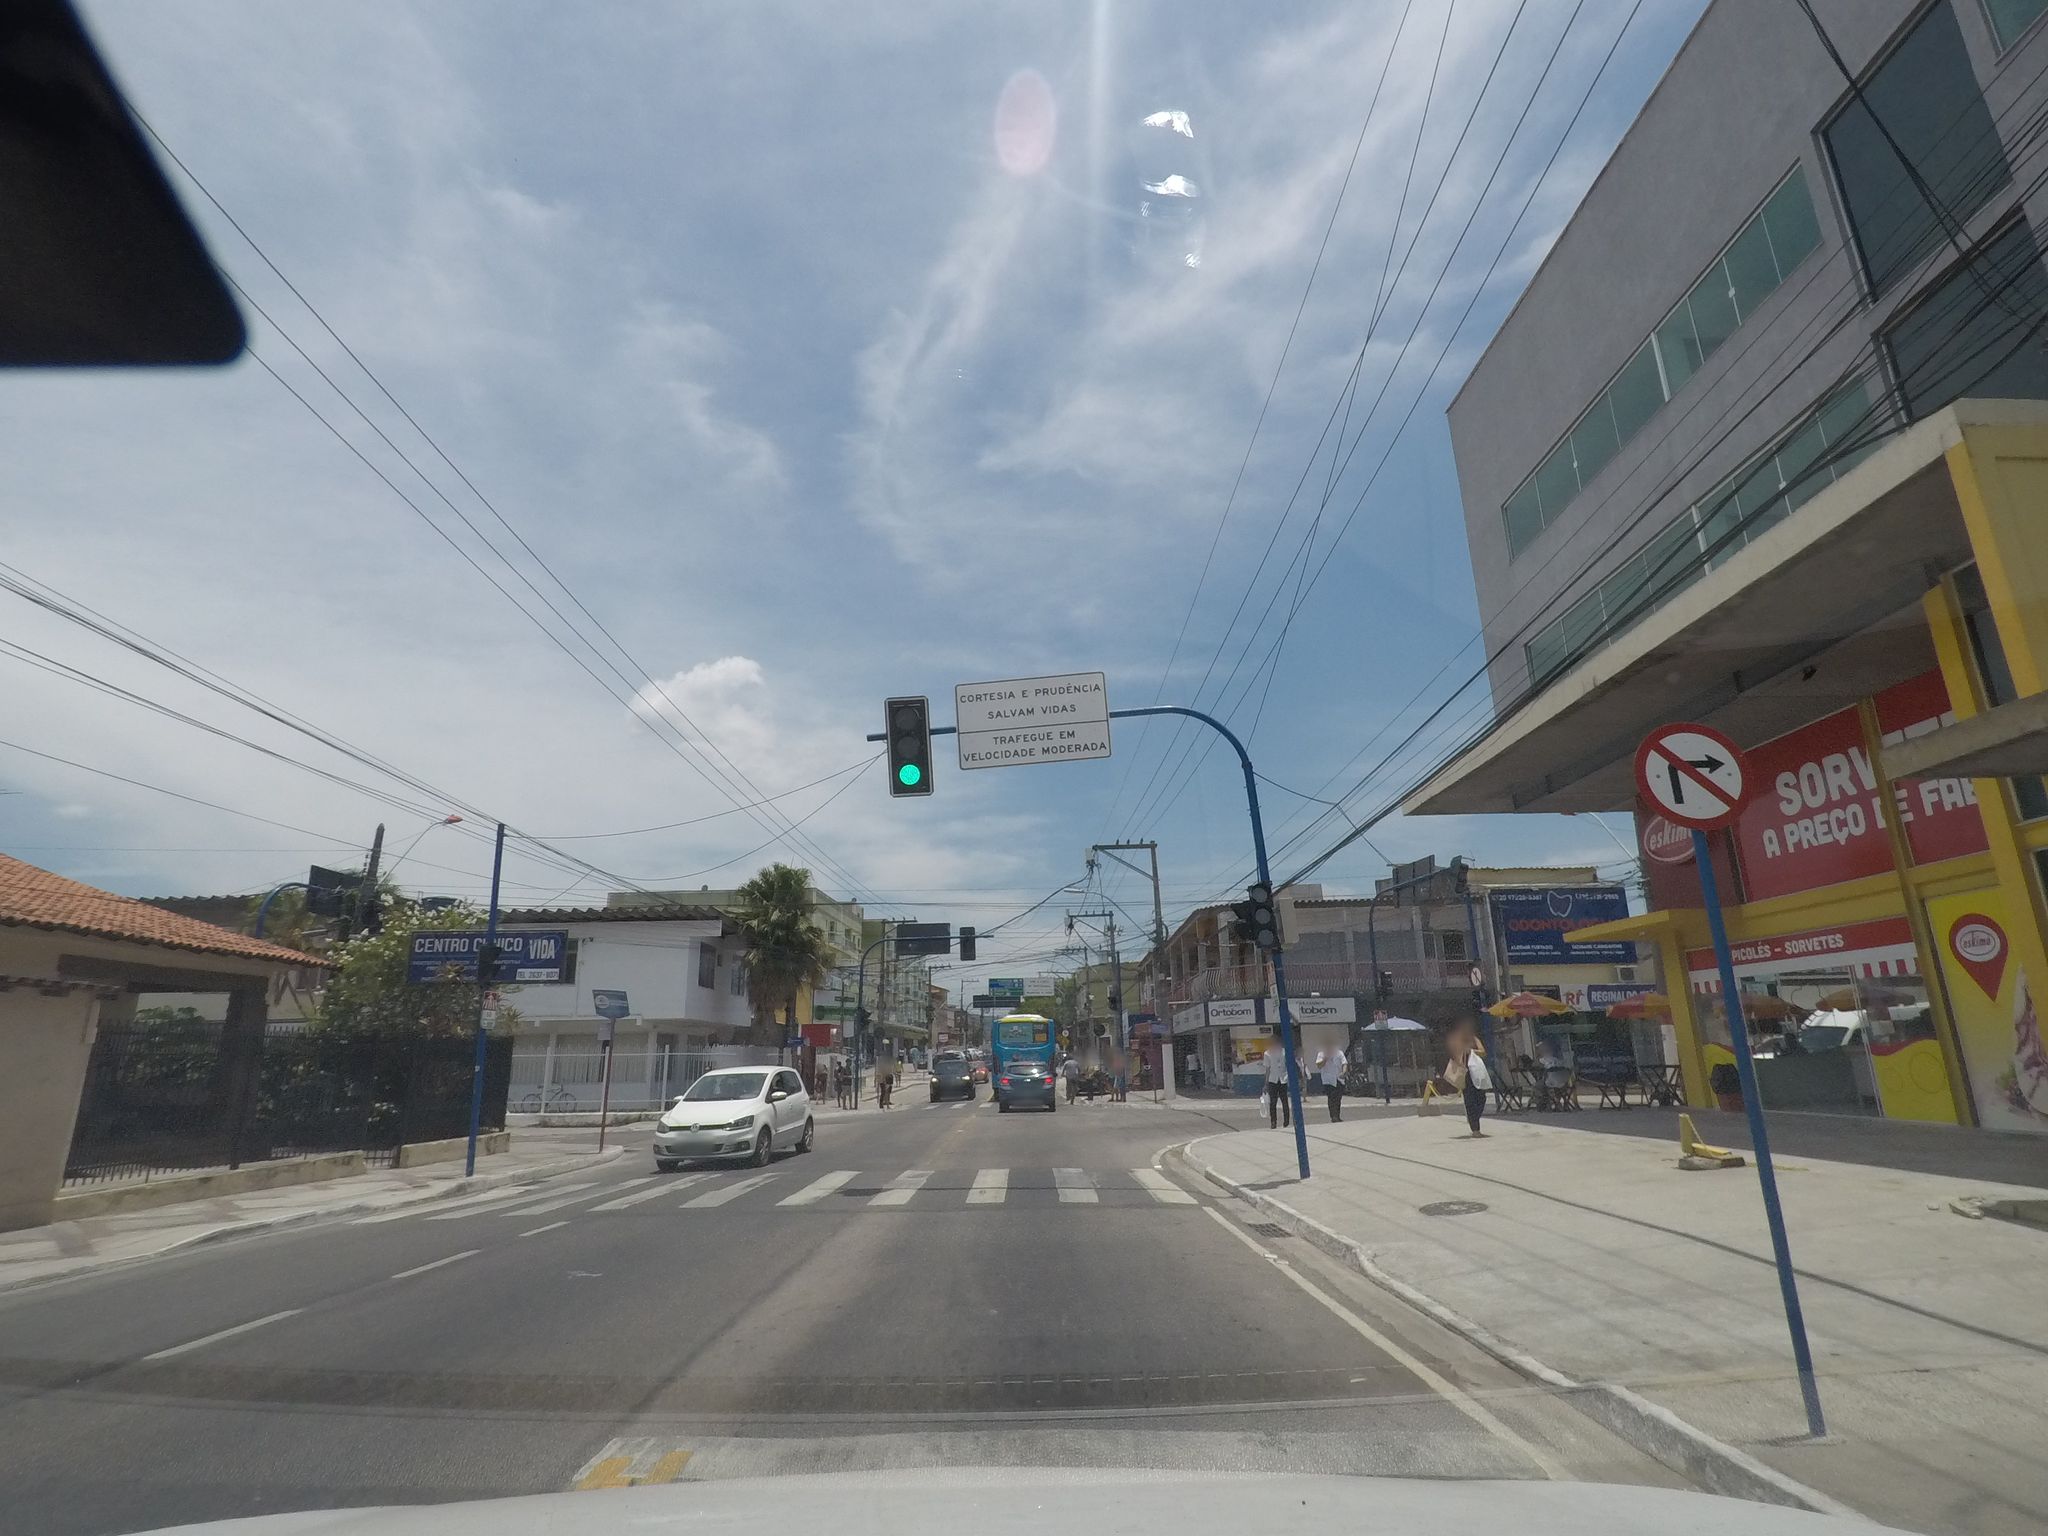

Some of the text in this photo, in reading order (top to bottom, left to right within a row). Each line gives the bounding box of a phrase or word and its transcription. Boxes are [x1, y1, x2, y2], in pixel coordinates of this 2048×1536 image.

[959, 682, 1102, 704] CORTESIA E PRUDÊNCIA
[987, 703, 1077, 720] SALVAM VIDAS
[992, 730, 1076, 746] TRAFEGUE EM
[962, 741, 1107, 762] VELOCIDADE MODERADA
[1762, 828, 1781, 859] A
[1783, 803, 1866, 853] PREÇO
[414, 937, 524, 953] CENTRO CNICO
[528, 938, 556, 960] VIDA
[1731, 941, 1771, 962] PICOLÉS
[1784, 933, 1845, 955] SORVETES
[1210, 1008, 1252, 1017] Ortobom
[1300, 1005, 1337, 1015] tobom
